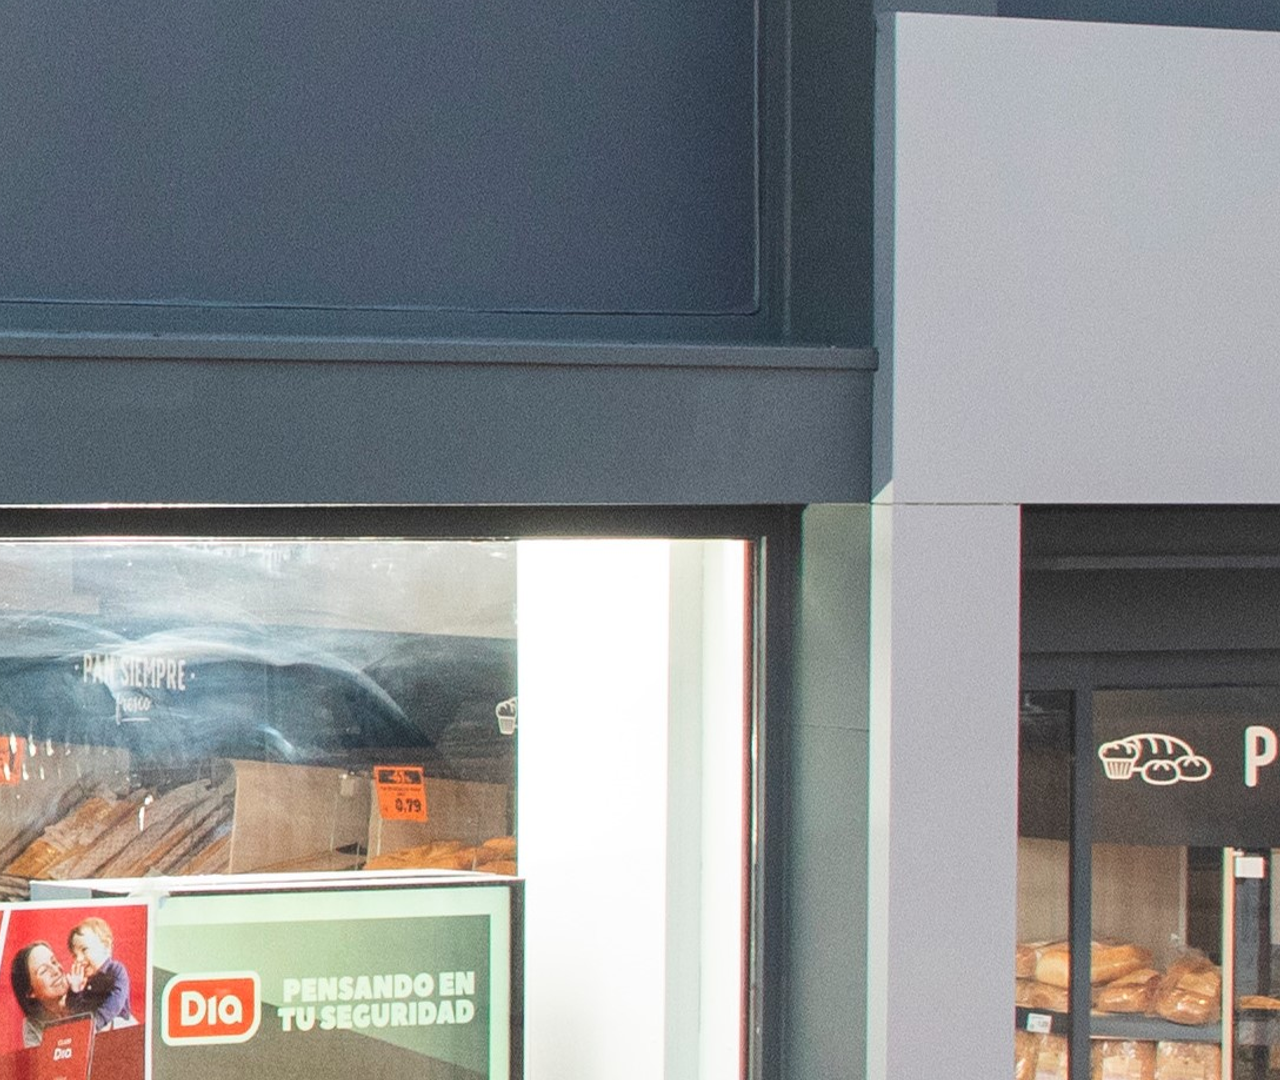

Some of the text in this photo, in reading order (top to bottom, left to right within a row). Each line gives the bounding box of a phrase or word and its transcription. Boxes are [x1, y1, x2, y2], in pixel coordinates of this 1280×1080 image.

[121, 657, 186, 691] SIEMPRE
[283, 971, 475, 1003] PENSANDO EN
[278, 999, 475, 1031] TU SEGURIDAD
